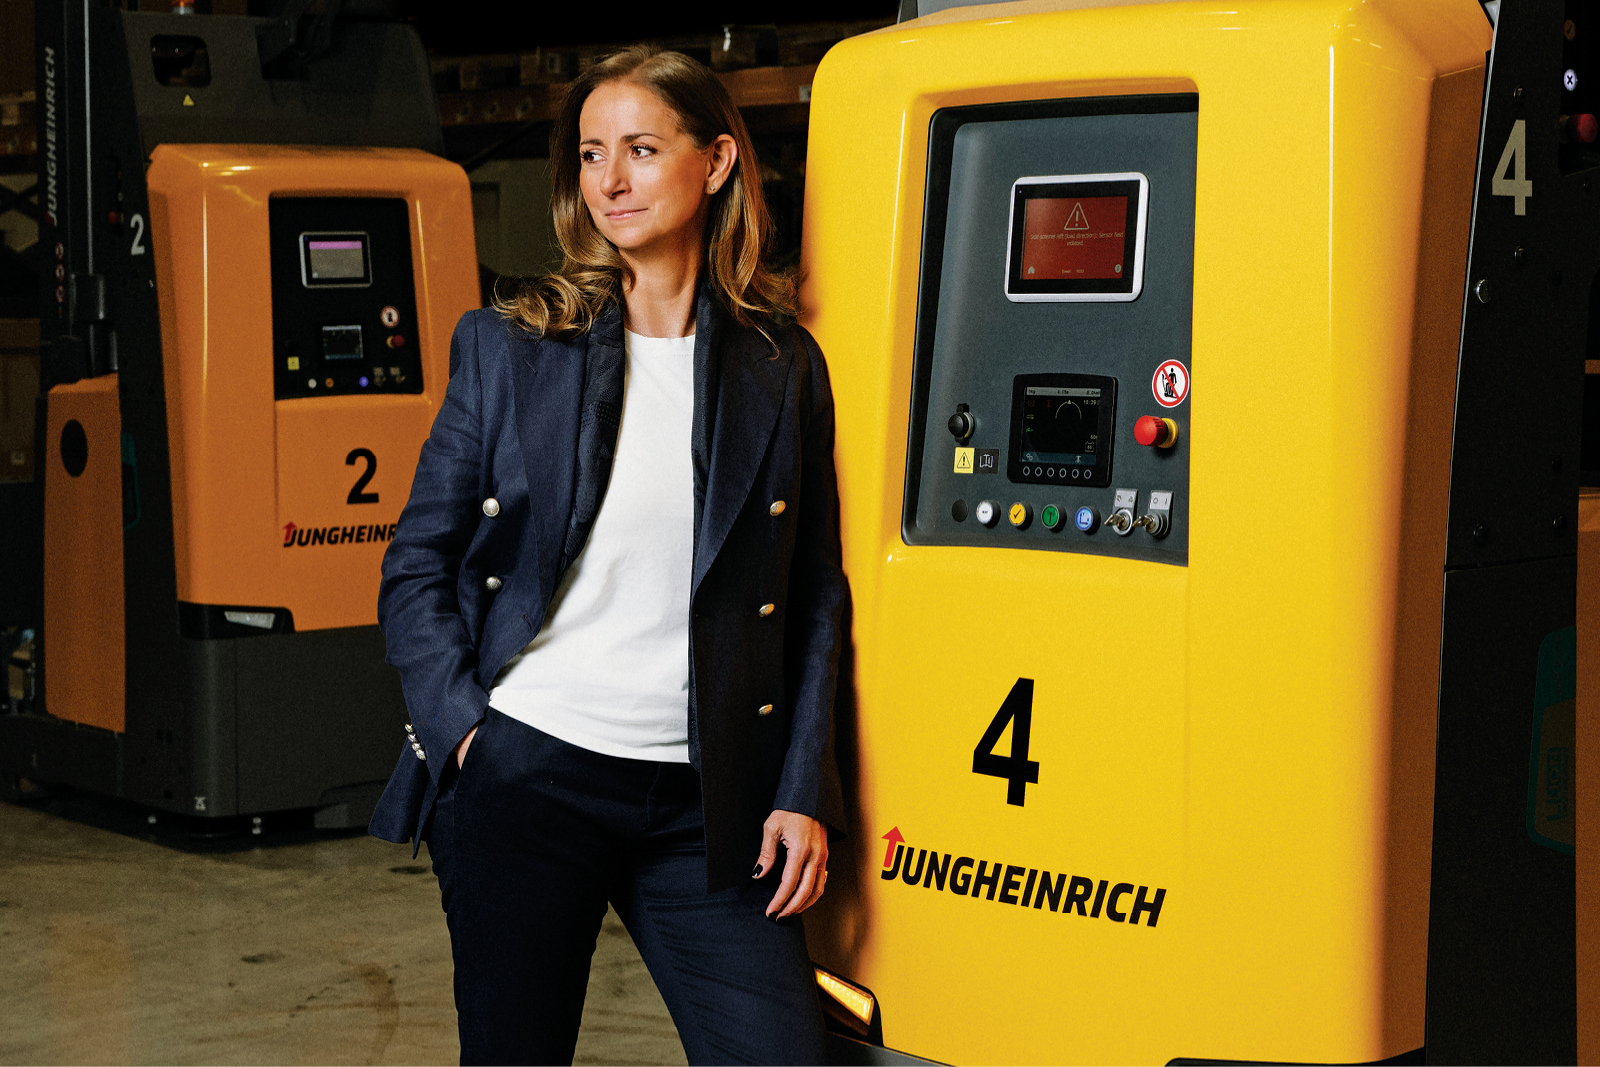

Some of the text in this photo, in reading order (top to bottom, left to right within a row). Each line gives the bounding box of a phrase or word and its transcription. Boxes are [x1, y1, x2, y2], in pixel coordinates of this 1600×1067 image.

[44, 46, 58, 227] JUNGHEINRICH
[1491, 119, 1533, 217] 4
[130, 213, 145, 256] 2
[345, 447, 380, 505] 2
[971, 677, 1040, 807] 4
[880, 844, 1167, 928] JUNGHEINRICH
